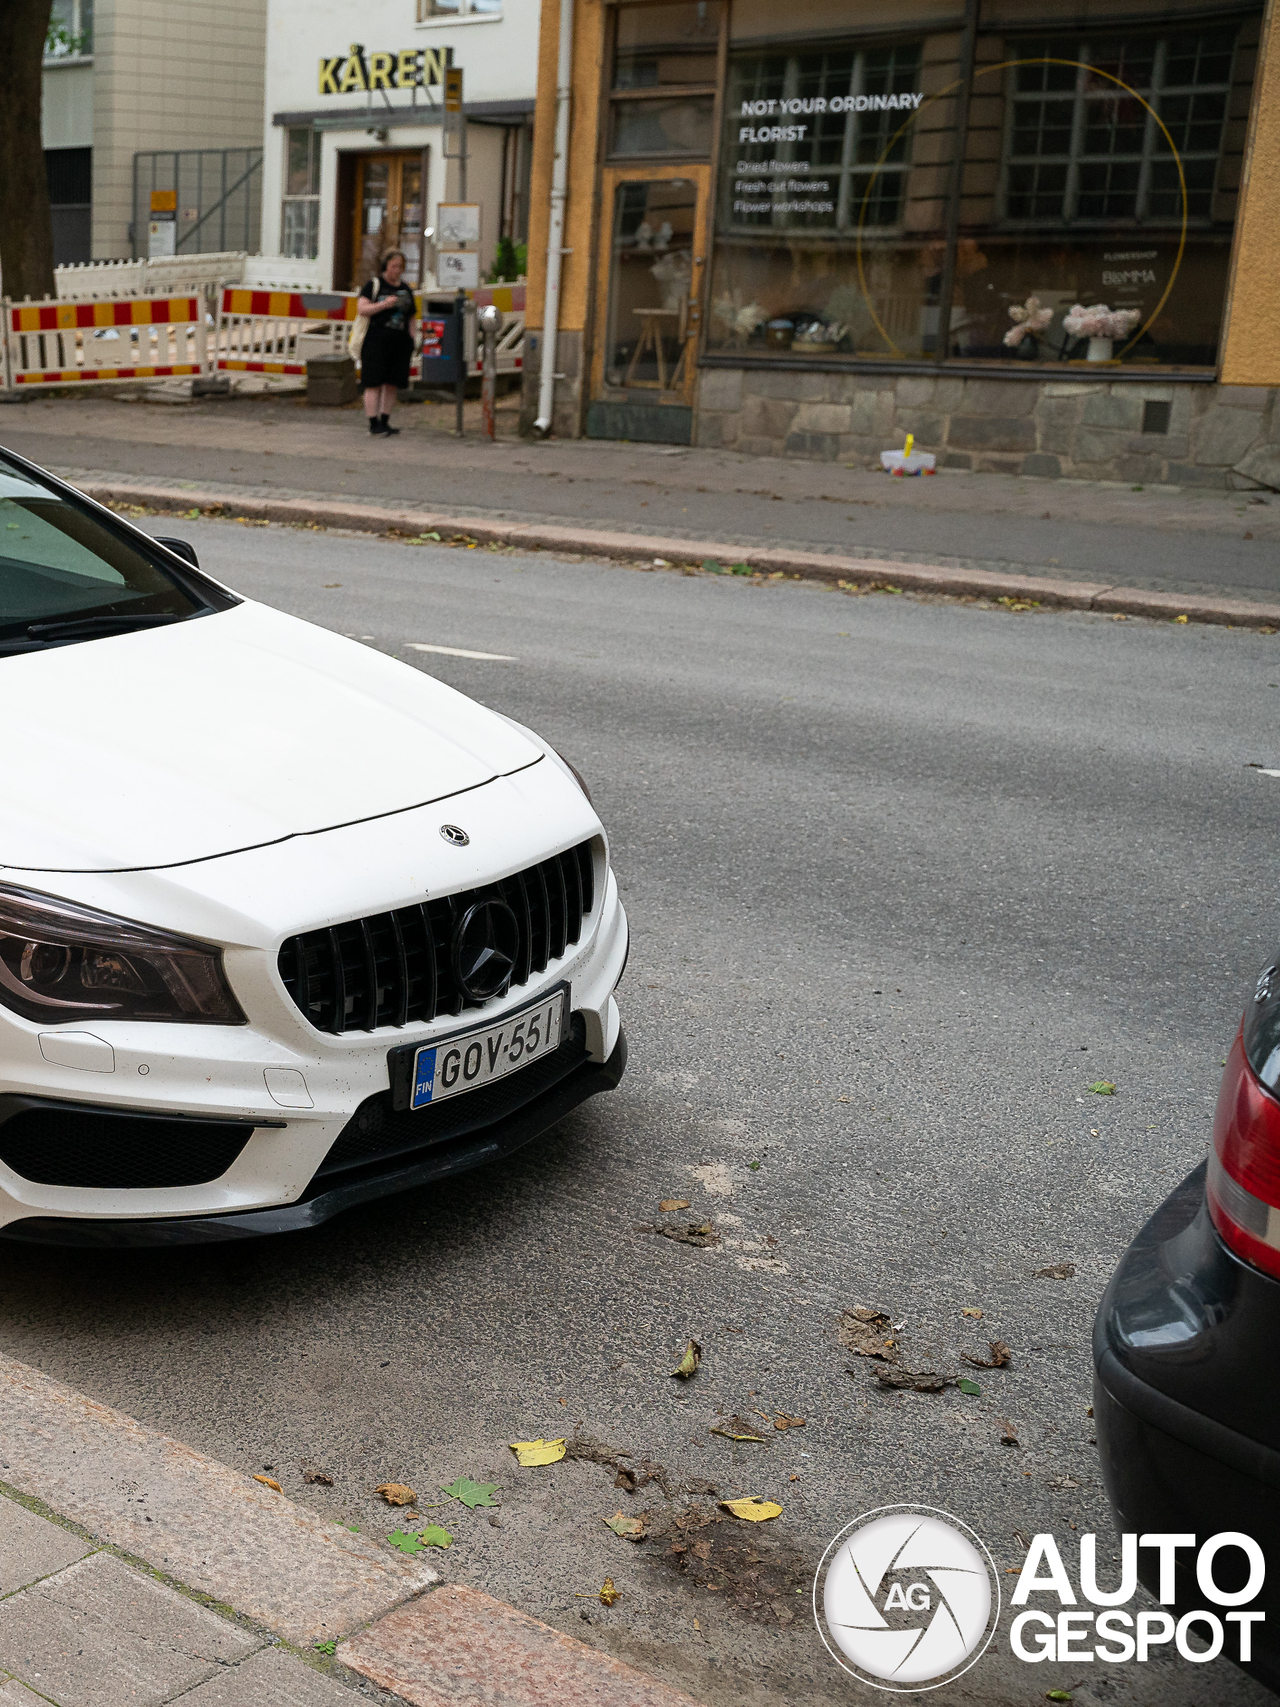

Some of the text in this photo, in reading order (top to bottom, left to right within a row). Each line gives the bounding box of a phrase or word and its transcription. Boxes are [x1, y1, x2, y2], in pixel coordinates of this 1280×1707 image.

[318, 43, 451, 94] KÅREN
[741, 92, 923, 116] NOT YOUR ORDINARY
[739, 125, 808, 143] FLORIST
[736, 159, 810, 174] Dried flowers
[735, 178, 830, 193] Fresh cut flowers
[733, 200, 834, 214] Flower workshops
[441, 1006, 553, 1088] GOV-551
[415, 1080, 433, 1096] FIN
